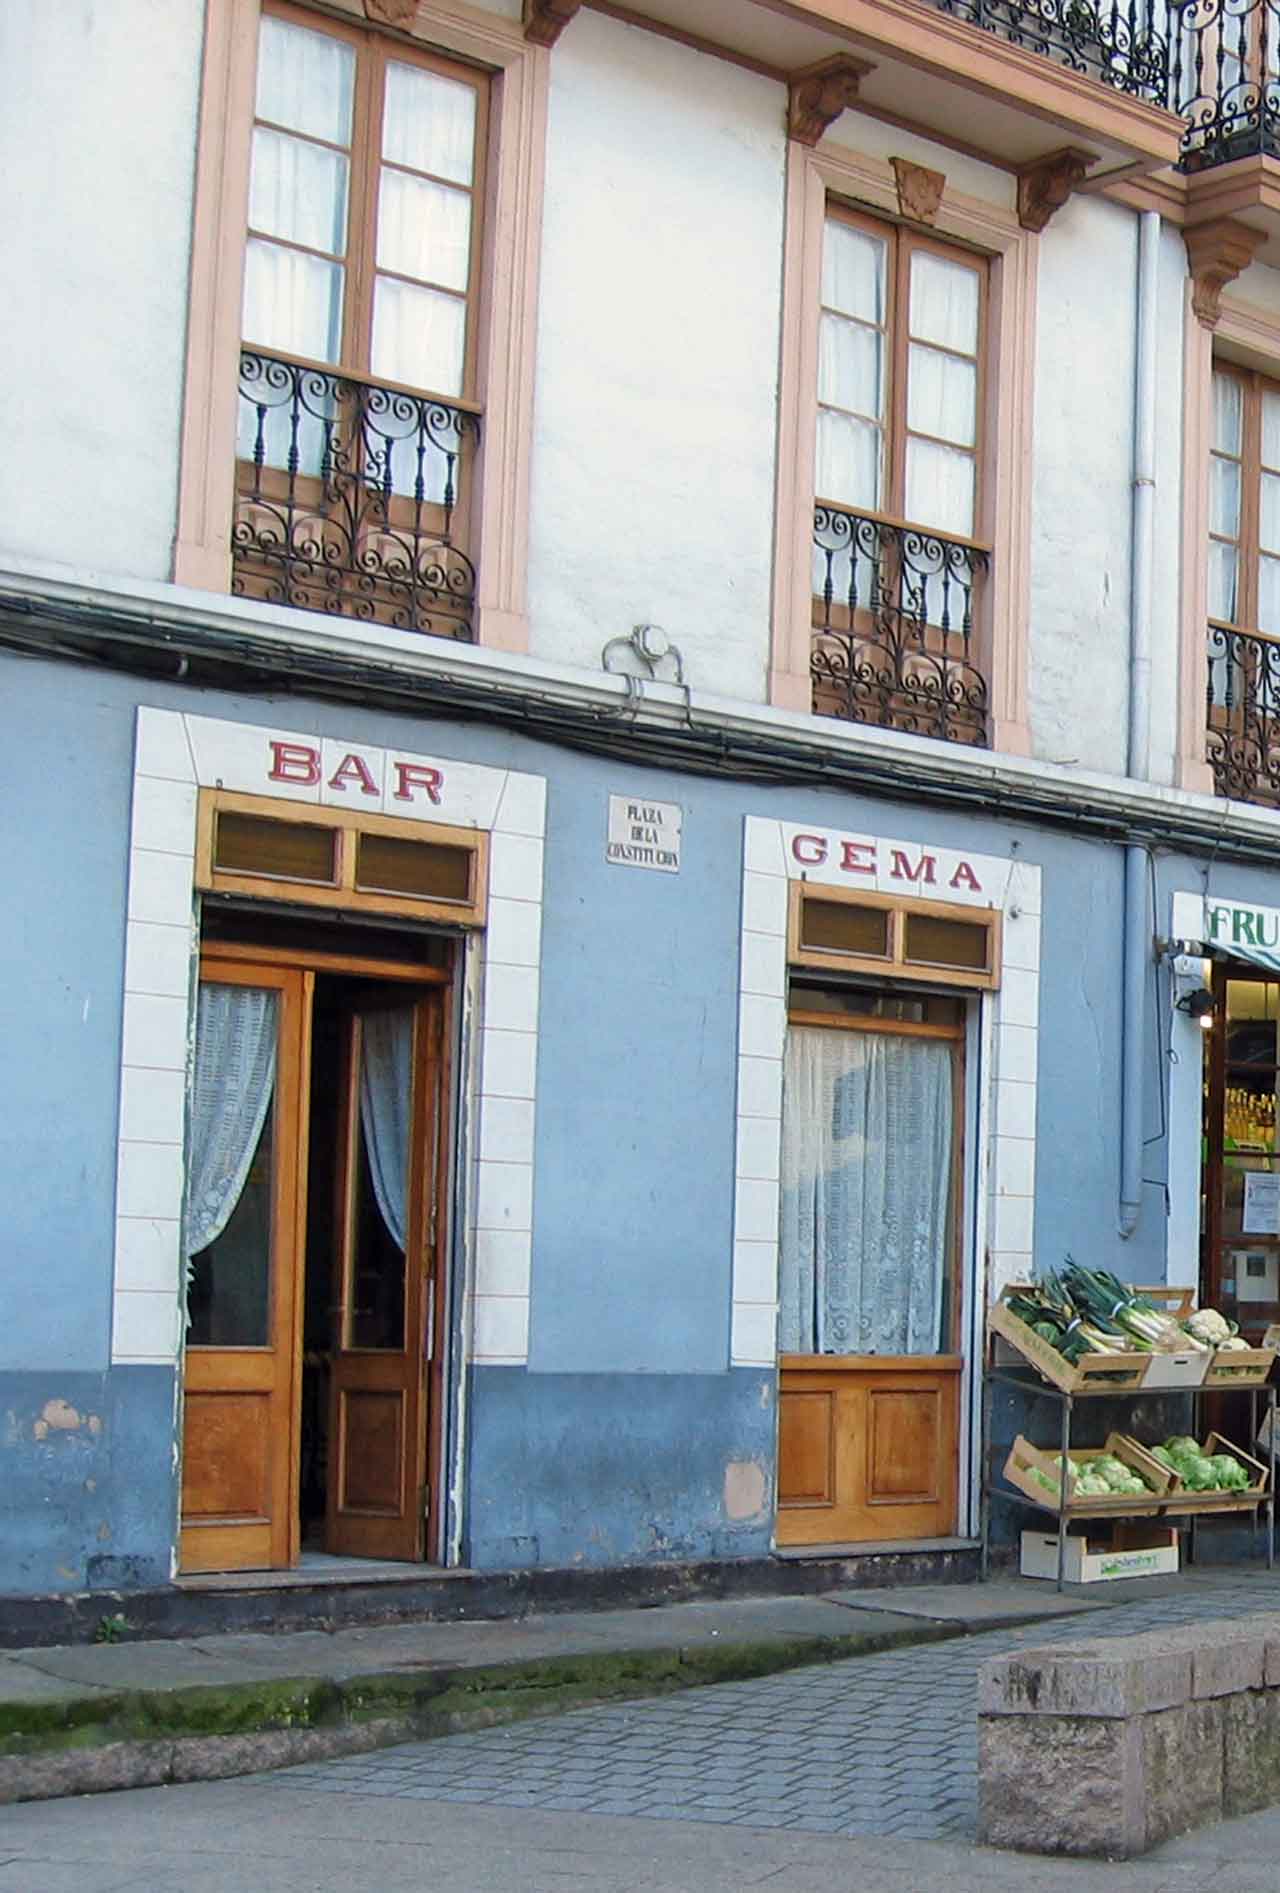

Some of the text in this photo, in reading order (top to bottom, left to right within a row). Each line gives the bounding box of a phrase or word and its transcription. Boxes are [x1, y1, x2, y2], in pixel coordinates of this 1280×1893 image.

[267, 740, 445, 805] BAR
[627, 805, 663, 824] PLAZA
[645, 828, 658, 844] LA
[791, 834, 983, 891] GEMA
